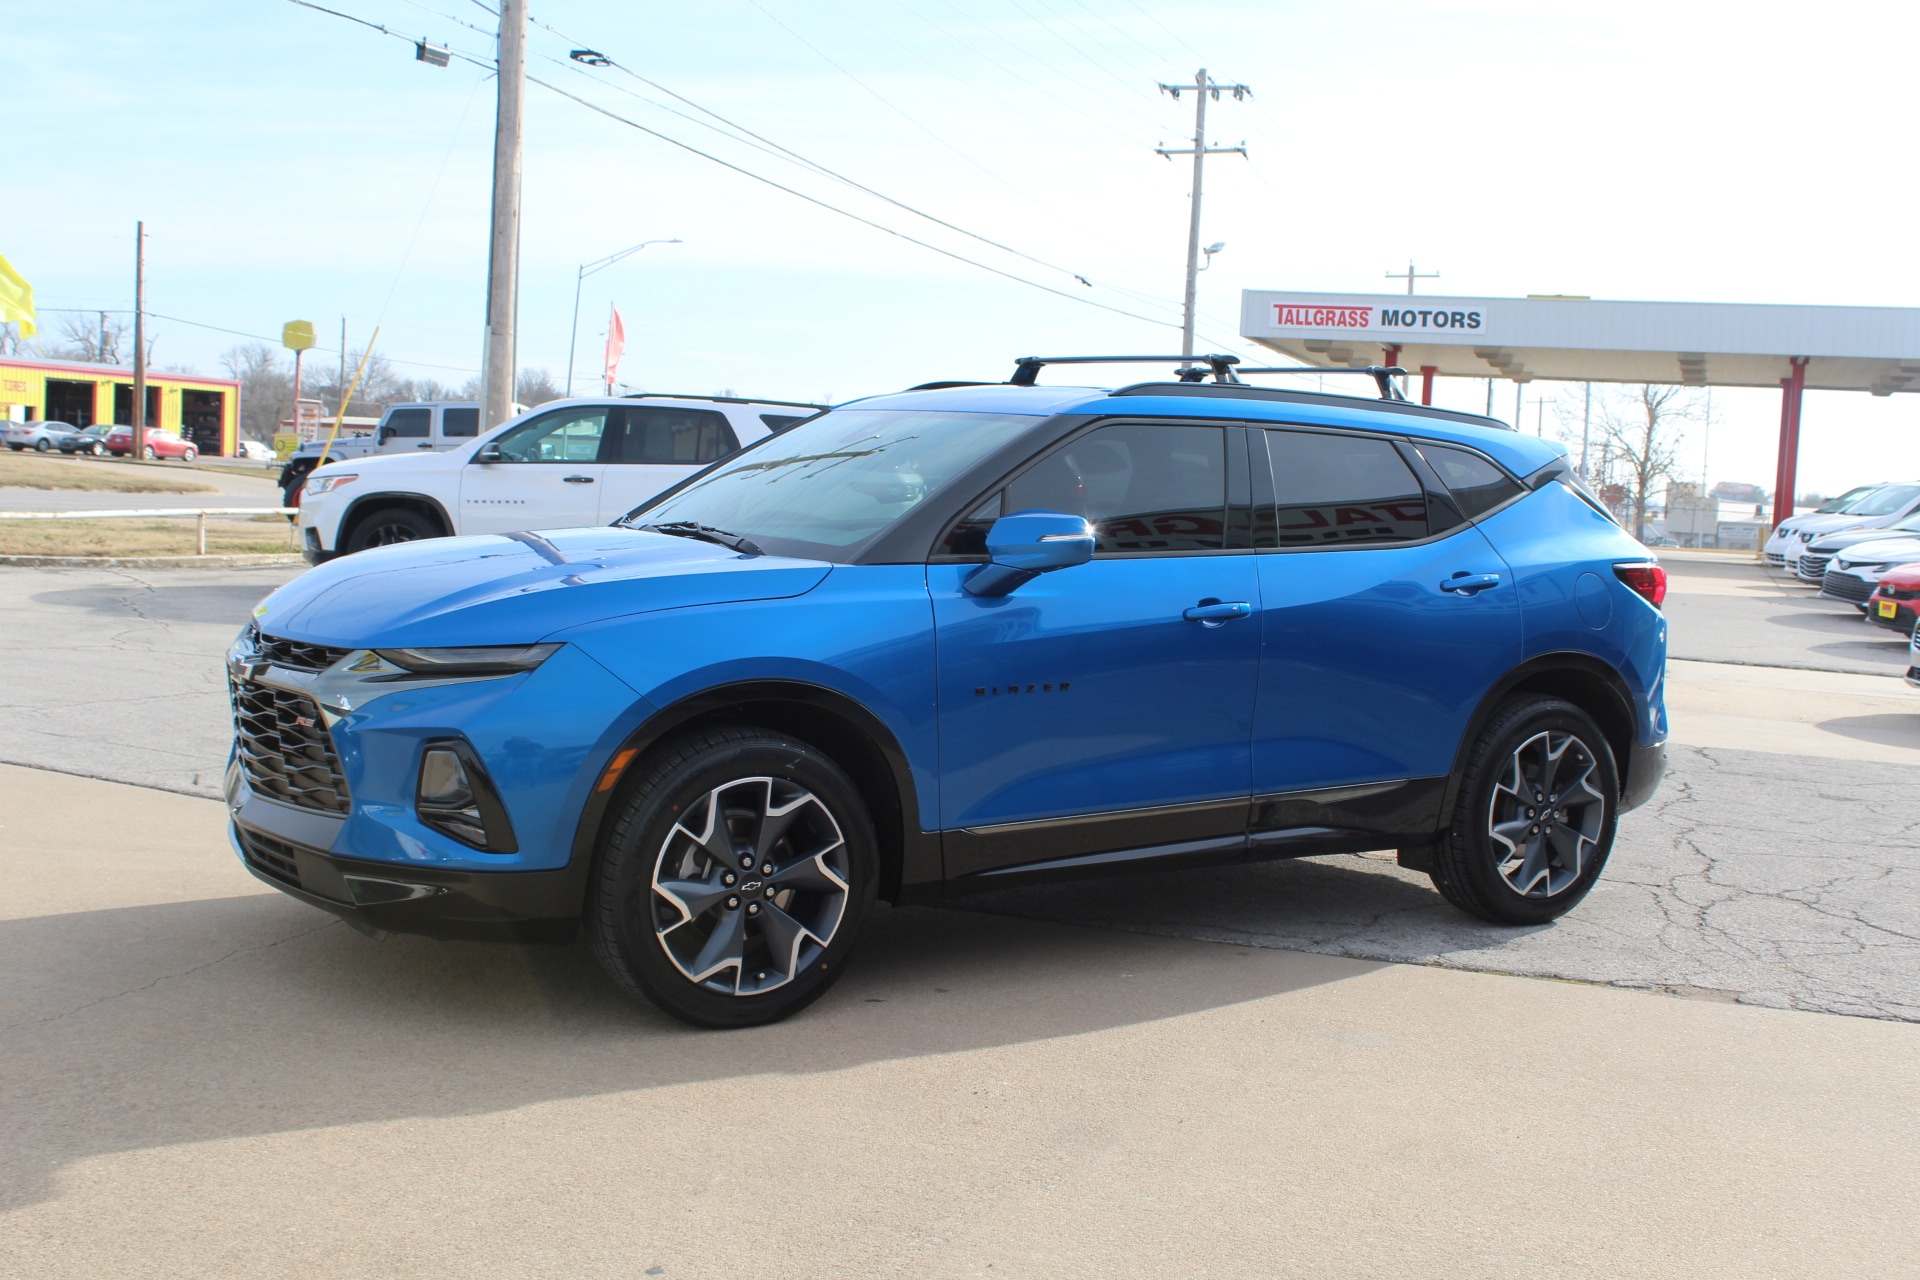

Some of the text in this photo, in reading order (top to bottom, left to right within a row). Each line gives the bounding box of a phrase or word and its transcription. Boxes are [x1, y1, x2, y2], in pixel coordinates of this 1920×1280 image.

[1273, 304, 1481, 329] TALLGRASS MOTORS
[975, 682, 1070, 697] BLAZER
